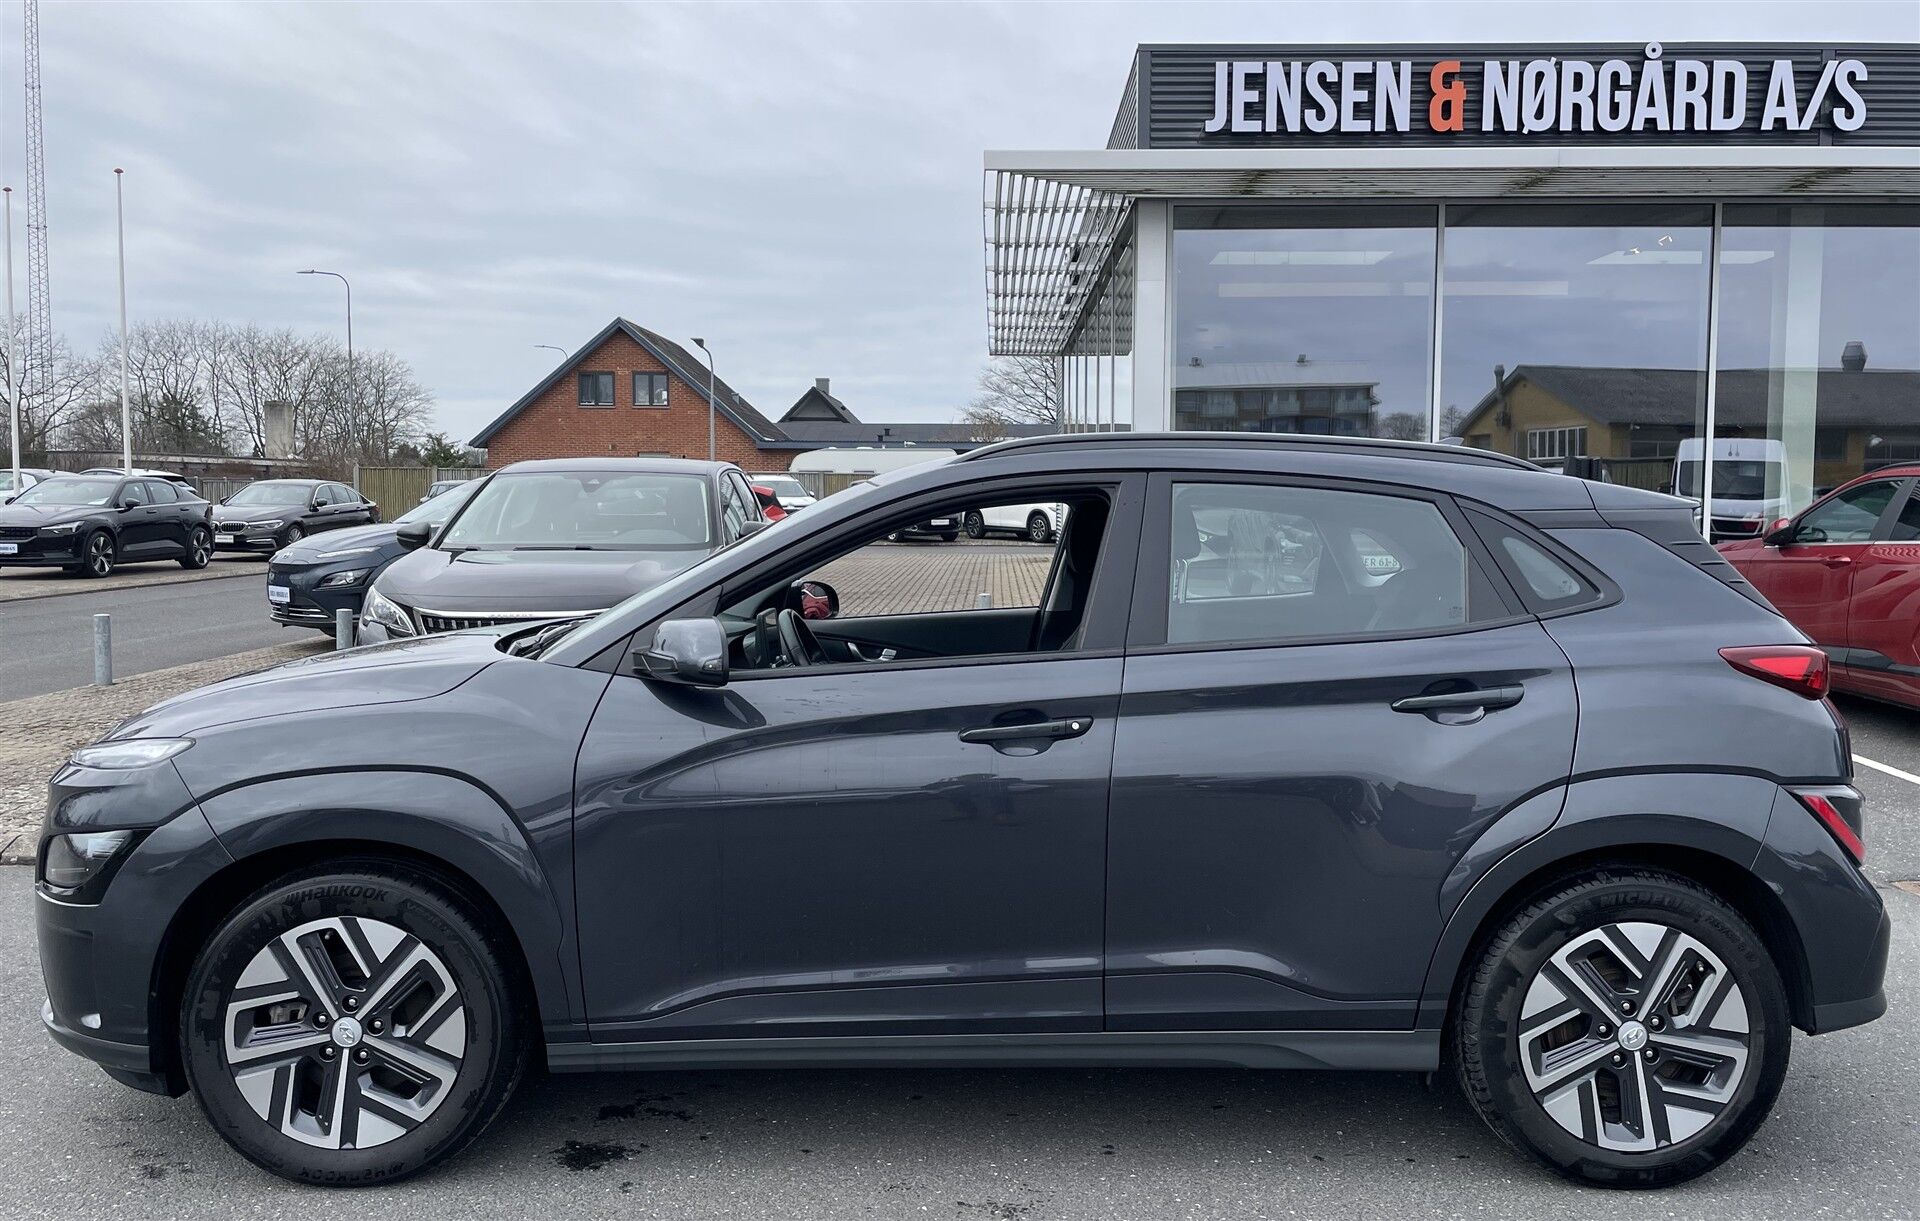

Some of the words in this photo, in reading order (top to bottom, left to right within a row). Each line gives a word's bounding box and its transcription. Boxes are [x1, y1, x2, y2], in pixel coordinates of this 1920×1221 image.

[1204, 60, 1412, 133] JENSEN
[1428, 60, 1465, 132] &
[1481, 41, 1748, 135] NØRGÅRD
[1760, 60, 1868, 132] A/S
